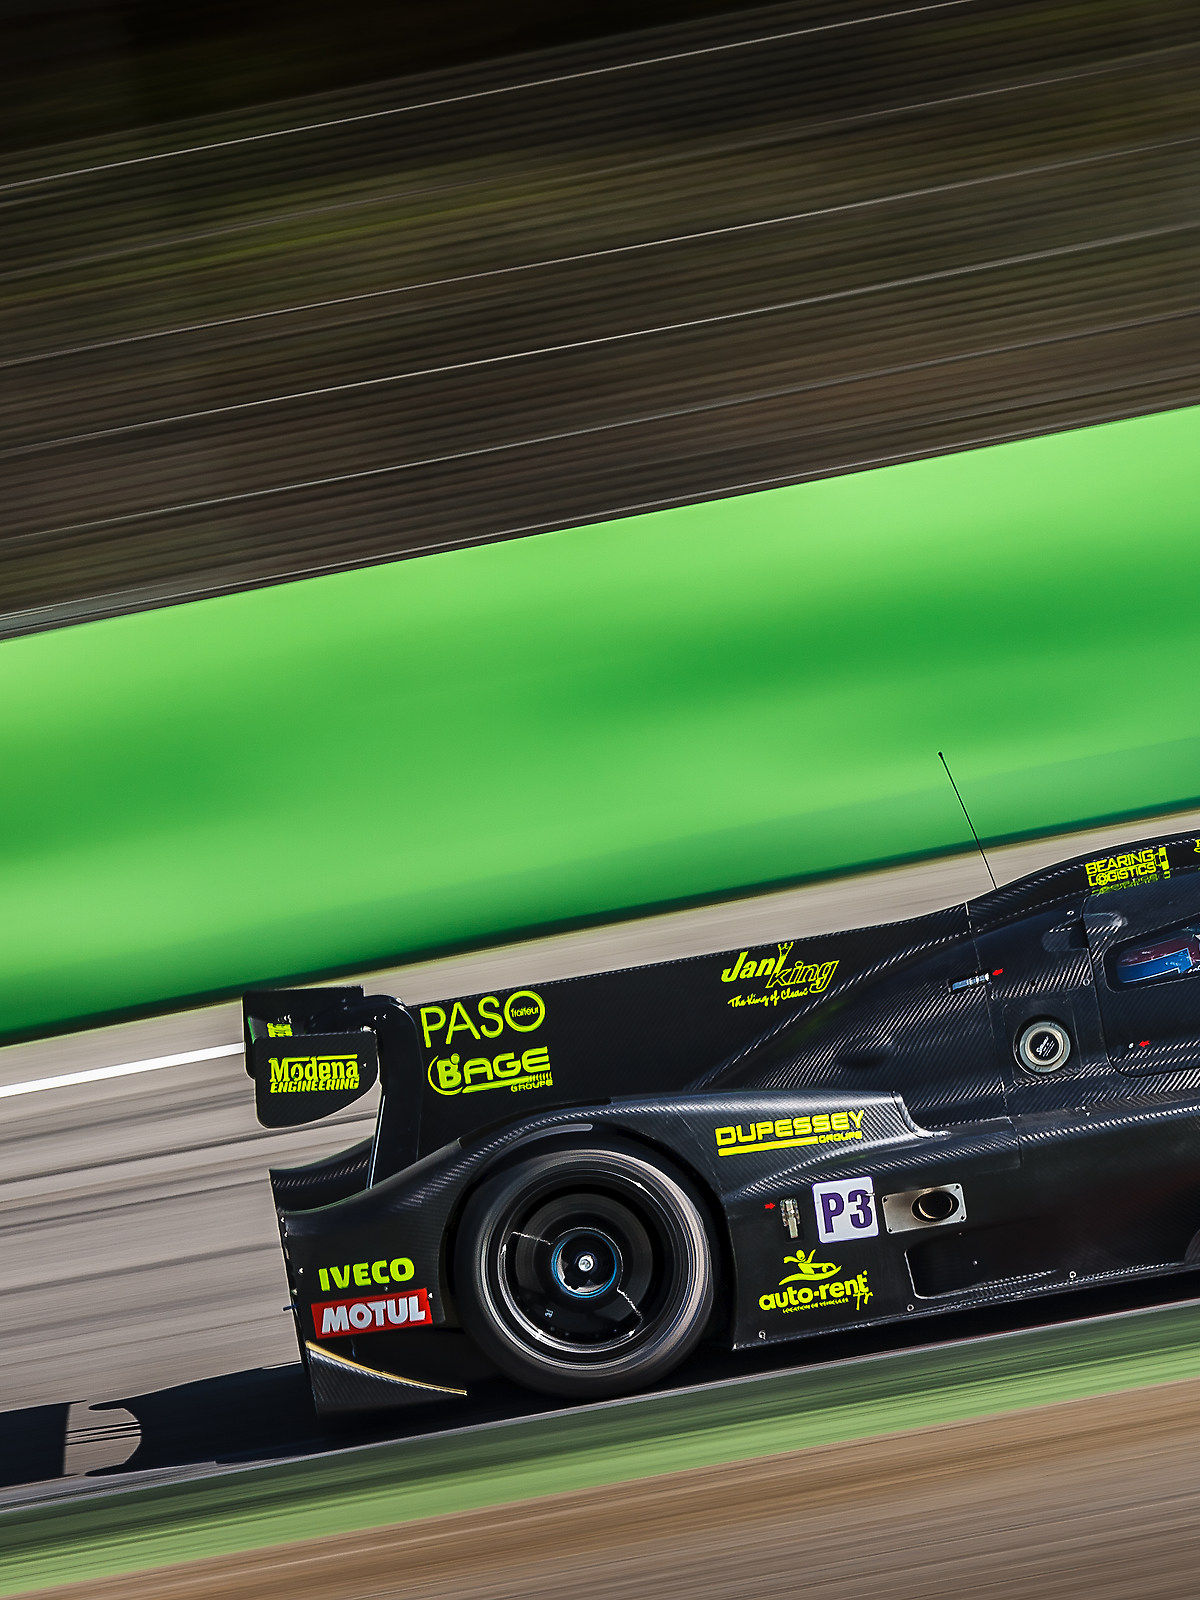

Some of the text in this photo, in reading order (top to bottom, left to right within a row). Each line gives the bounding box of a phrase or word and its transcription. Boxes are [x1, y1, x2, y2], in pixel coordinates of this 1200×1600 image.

[1085, 848, 1154, 875] BEARING
[1088, 860, 1157, 887] LOGISTICS
[769, 989, 781, 1007] of
[420, 990, 546, 1049] PASO
[267, 1054, 359, 1083] Modena
[436, 1046, 551, 1089] BAGE
[269, 1077, 360, 1094] ENGINEERING
[510, 1078, 554, 1093] GROUPE
[714, 1110, 864, 1146] DUPESSEY
[818, 1130, 864, 1144] GROUPE
[820, 1189, 873, 1234] P3
[318, 1257, 416, 1292] IVECO
[320, 1295, 426, 1335] MOTUL
